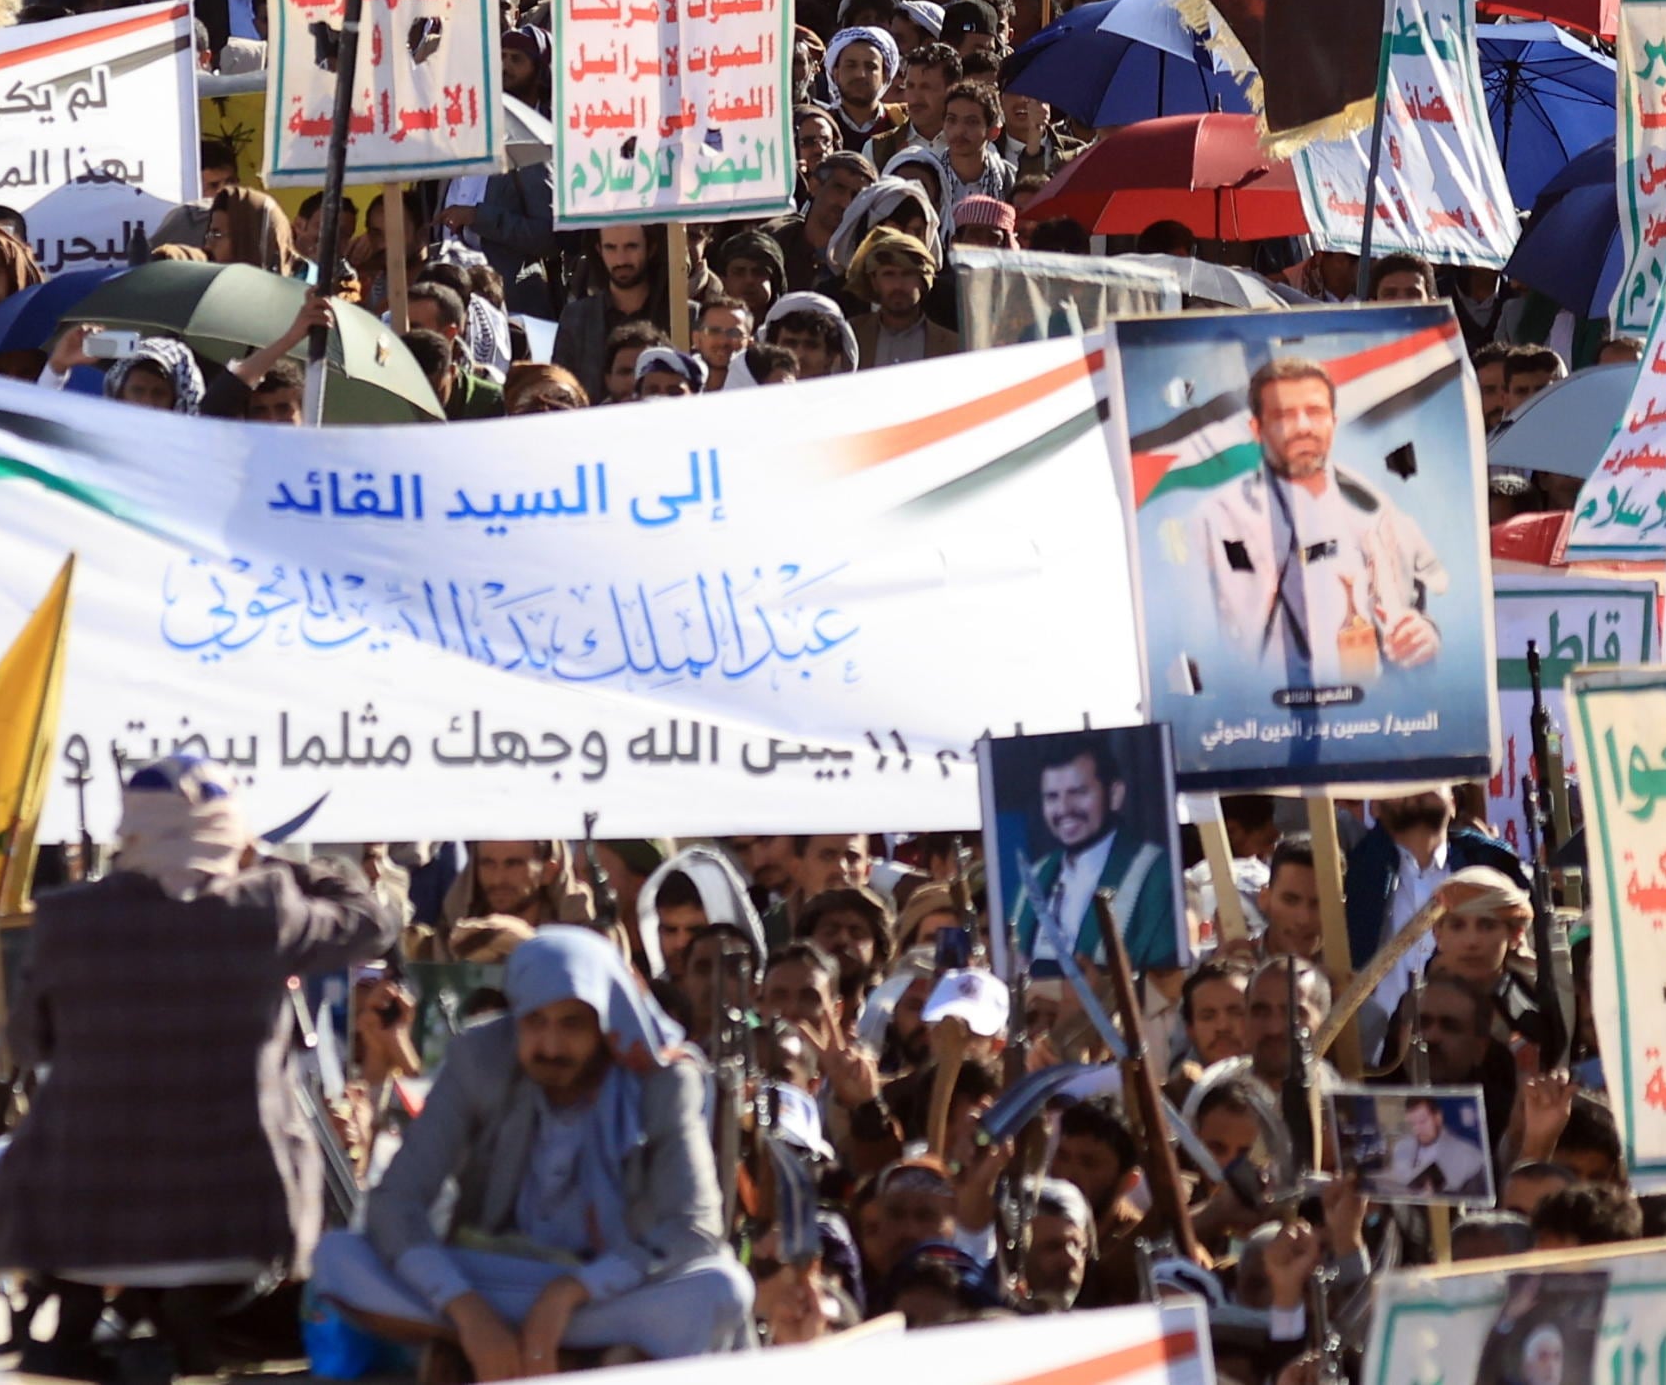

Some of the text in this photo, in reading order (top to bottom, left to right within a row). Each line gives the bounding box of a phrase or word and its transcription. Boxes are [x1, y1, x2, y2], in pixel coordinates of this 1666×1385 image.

[687, 33, 774, 77] الموت
[67, 68, 108, 121] لم
[569, 85, 774, 139] اللعنة على اليهود
[64, 146, 145, 195] بهذا
[684, 133, 776, 200] النصر
[268, 448, 724, 536] إلى السيد القائد
[278, 702, 413, 769] مثلما
[431, 709, 609, 781] وجهك
[627, 718, 719, 768] الله
[1200, 717, 1257, 751] الحوثي
[1260, 721, 1302, 742] الدين
[1333, 718, 1381, 739] حسين
